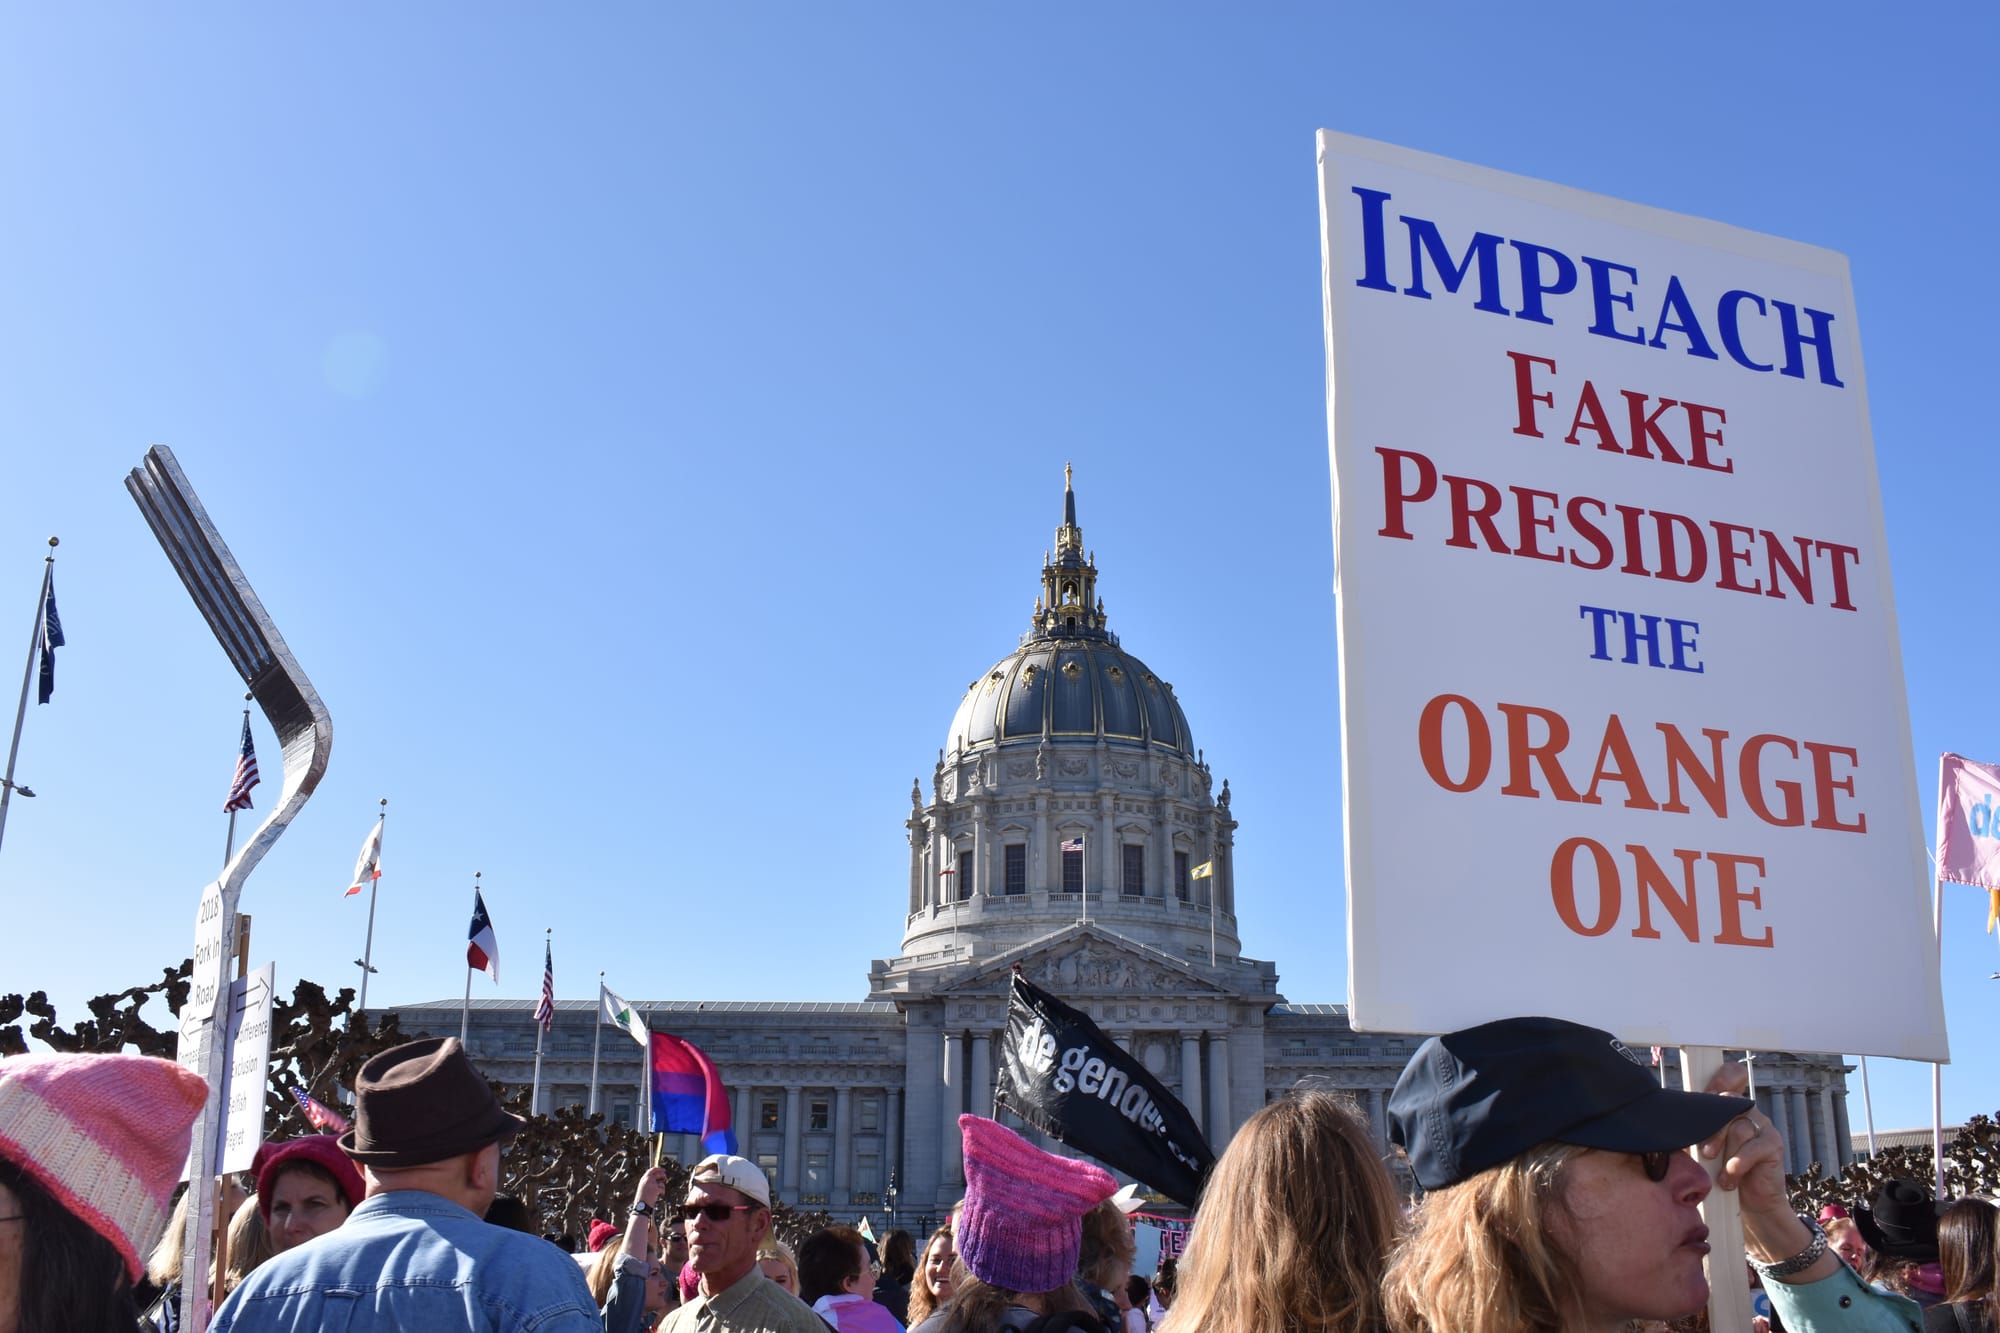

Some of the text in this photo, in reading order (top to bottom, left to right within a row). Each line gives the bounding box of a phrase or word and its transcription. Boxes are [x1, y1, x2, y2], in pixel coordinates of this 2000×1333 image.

[1352, 187, 1844, 388] IMPEACH
[1507, 351, 1733, 474] FAKE
[1375, 447, 1859, 611] PRESIDENT
[1580, 605, 1703, 673] THE
[1419, 694, 1866, 833] ORANGE
[200, 894, 219, 924] 2018
[1551, 837, 1772, 947] ONE
[195, 936, 220, 967] Fork In
[195, 977, 215, 1007] Road
[1019, 1017, 1056, 1073] de
